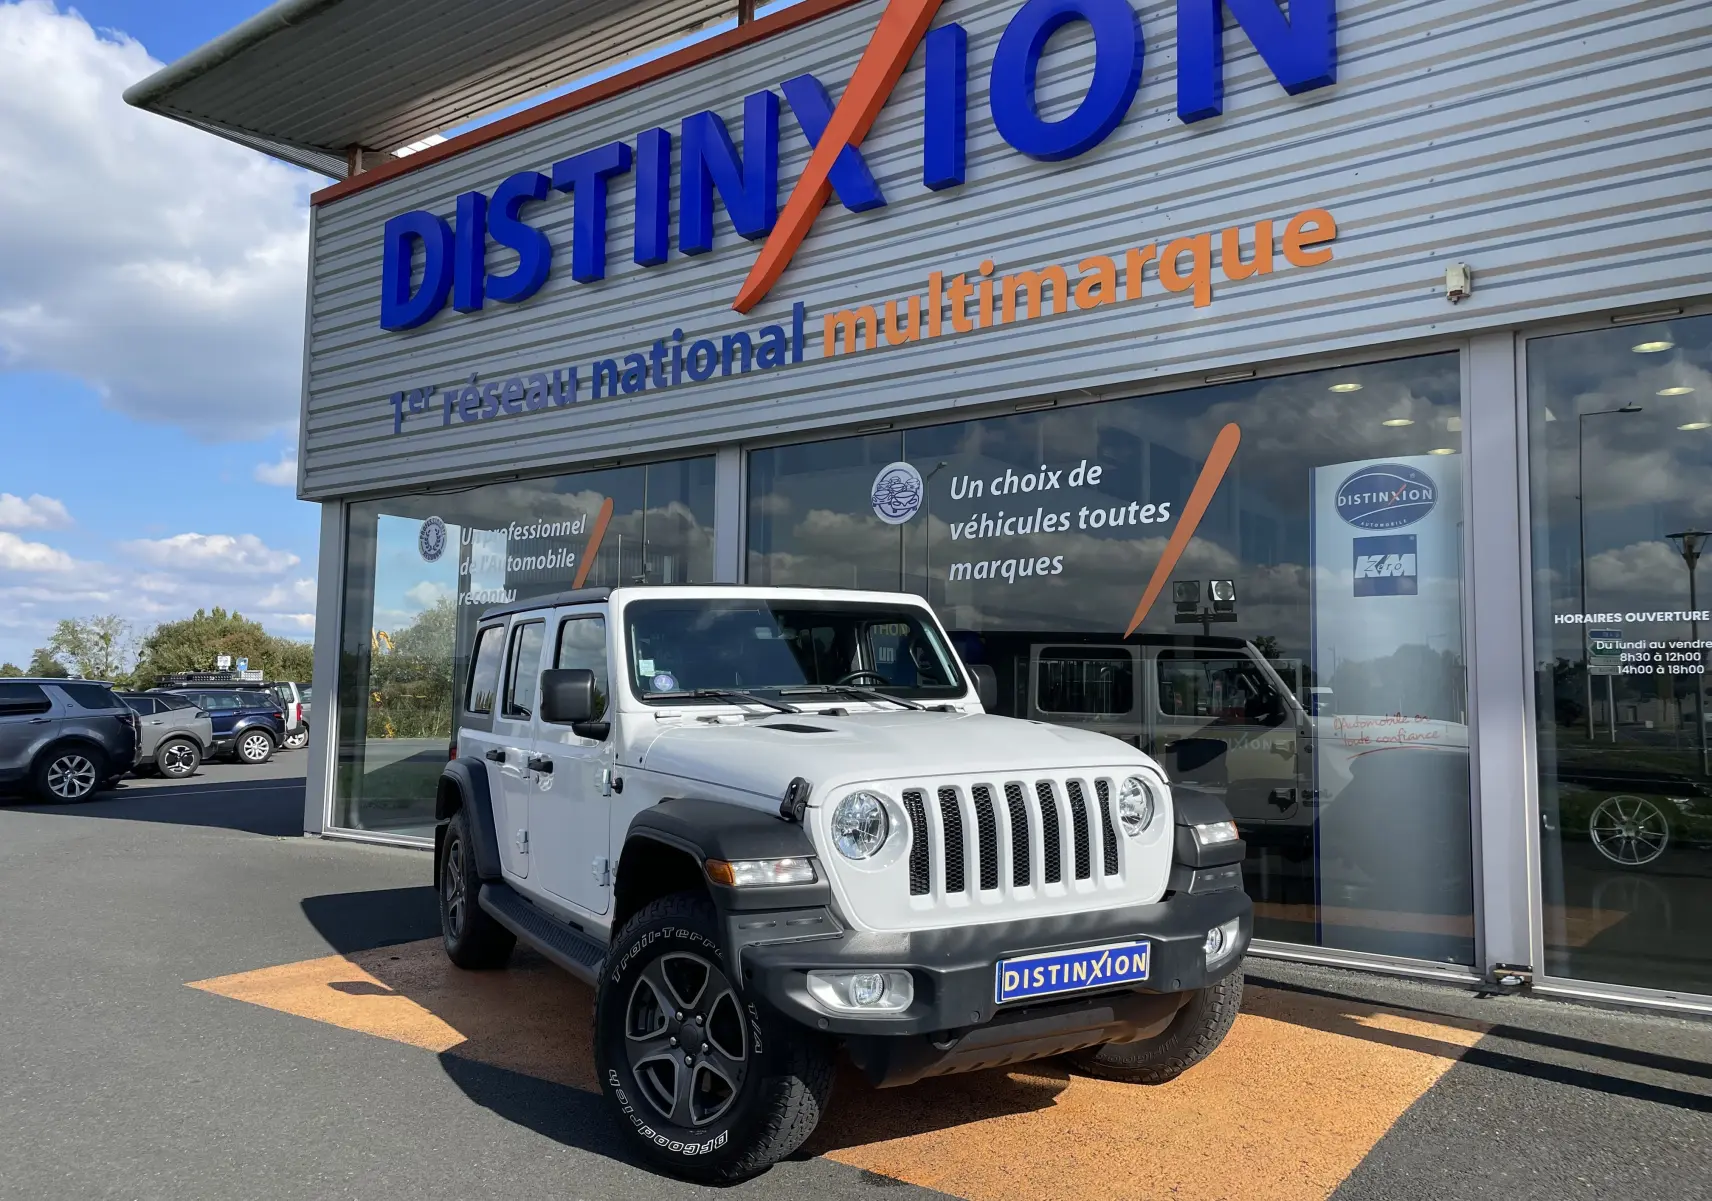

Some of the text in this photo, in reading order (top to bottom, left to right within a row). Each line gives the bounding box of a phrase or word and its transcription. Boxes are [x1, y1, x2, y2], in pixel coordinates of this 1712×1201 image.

[380, 0, 1337, 332] DISTINXION
[389, 208, 1336, 434] 1er réseau national multimarque
[950, 459, 1103, 500] Un choix de
[1337, 483, 1433, 507] DISTINXION
[482, 512, 588, 547] professionnel
[949, 500, 1171, 540] véhicules toutes
[1360, 518, 1408, 528] AUTOMOBILE
[949, 554, 1064, 584] marques
[1354, 553, 1417, 579] KM
[1363, 560, 1403, 572] Zero
[458, 588, 518, 606] reconnu
[1554, 610, 1711, 624] HORAIRES OUVERTURE
[1596, 640, 1613, 650] Du
[1616, 639, 1647, 649] lundi
[1649, 641, 1666, 649] au
[1620, 652, 1651, 662] 8h30
[1653, 651, 1662, 662] à
[1665, 652, 1702, 662] 12h00
[1617, 665, 1654, 675] 14h00
[1656, 664, 1665, 674] à
[1668, 664, 1705, 674] 18h00
[1375, 727, 1441, 743] confiance
[1004, 950, 1146, 992] DISTINXION
[608, 1069, 729, 1156] BFGoodrich
